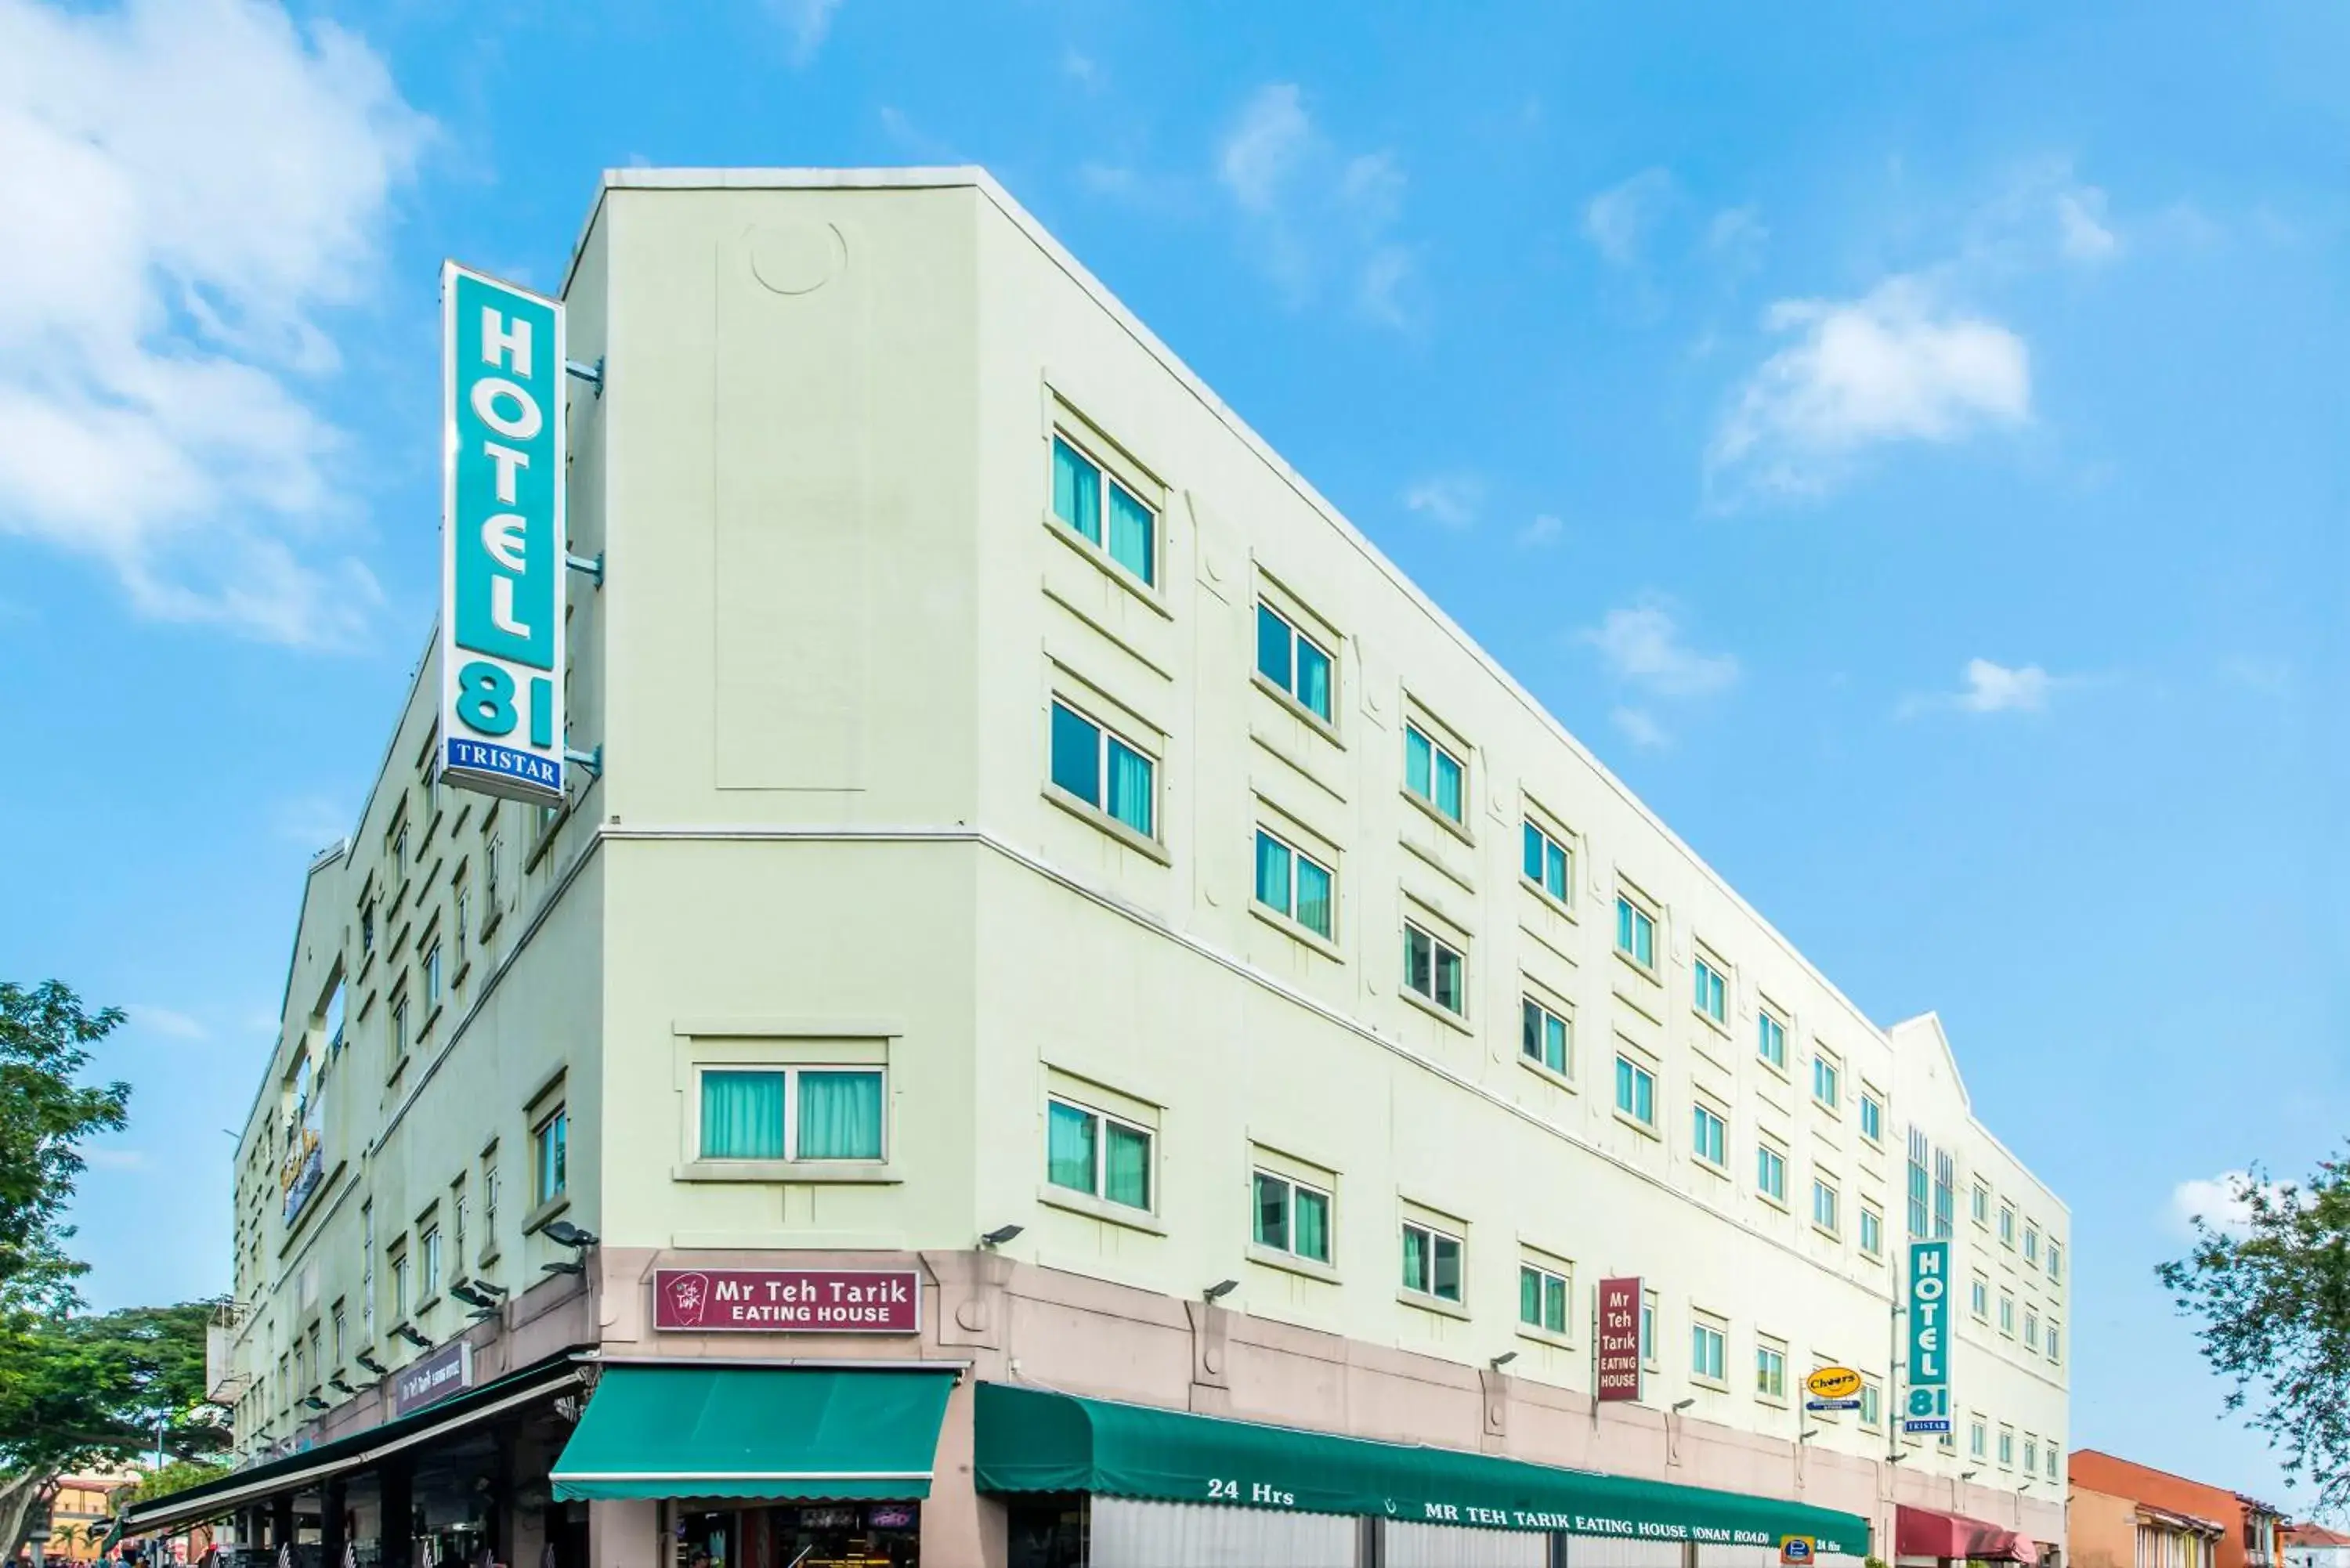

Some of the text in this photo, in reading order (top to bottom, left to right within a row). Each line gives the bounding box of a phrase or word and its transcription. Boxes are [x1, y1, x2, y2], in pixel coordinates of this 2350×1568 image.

[471, 306, 543, 641] HOTEL
[457, 661, 552, 750] 81
[457, 743, 554, 782] TRISTAR
[714, 1279, 907, 1303] Mr Teh Tarik
[1610, 1292, 1629, 1307] Mr
[732, 1306, 890, 1322] EATING HOUSE
[1607, 1310, 1632, 1328] Teh
[1915, 1251, 1943, 1376] HOTEL
[1602, 1331, 1636, 1349] Tarik
[1600, 1357, 1636, 1370] EATING
[1600, 1374, 1636, 1388] HOUSE
[1909, 1389, 1947, 1416] 81
[1907, 1422, 1947, 1430] TRISTAR
[1207, 1479, 1294, 1505] 24 Hrs
[1425, 1503, 1459, 1520] MR
[1466, 1507, 1508, 1525] TEH
[1513, 1512, 1570, 1528] TARIK
[1575, 1516, 1632, 1534] EATING
[1638, 1522, 1687, 1538] HOUSE
